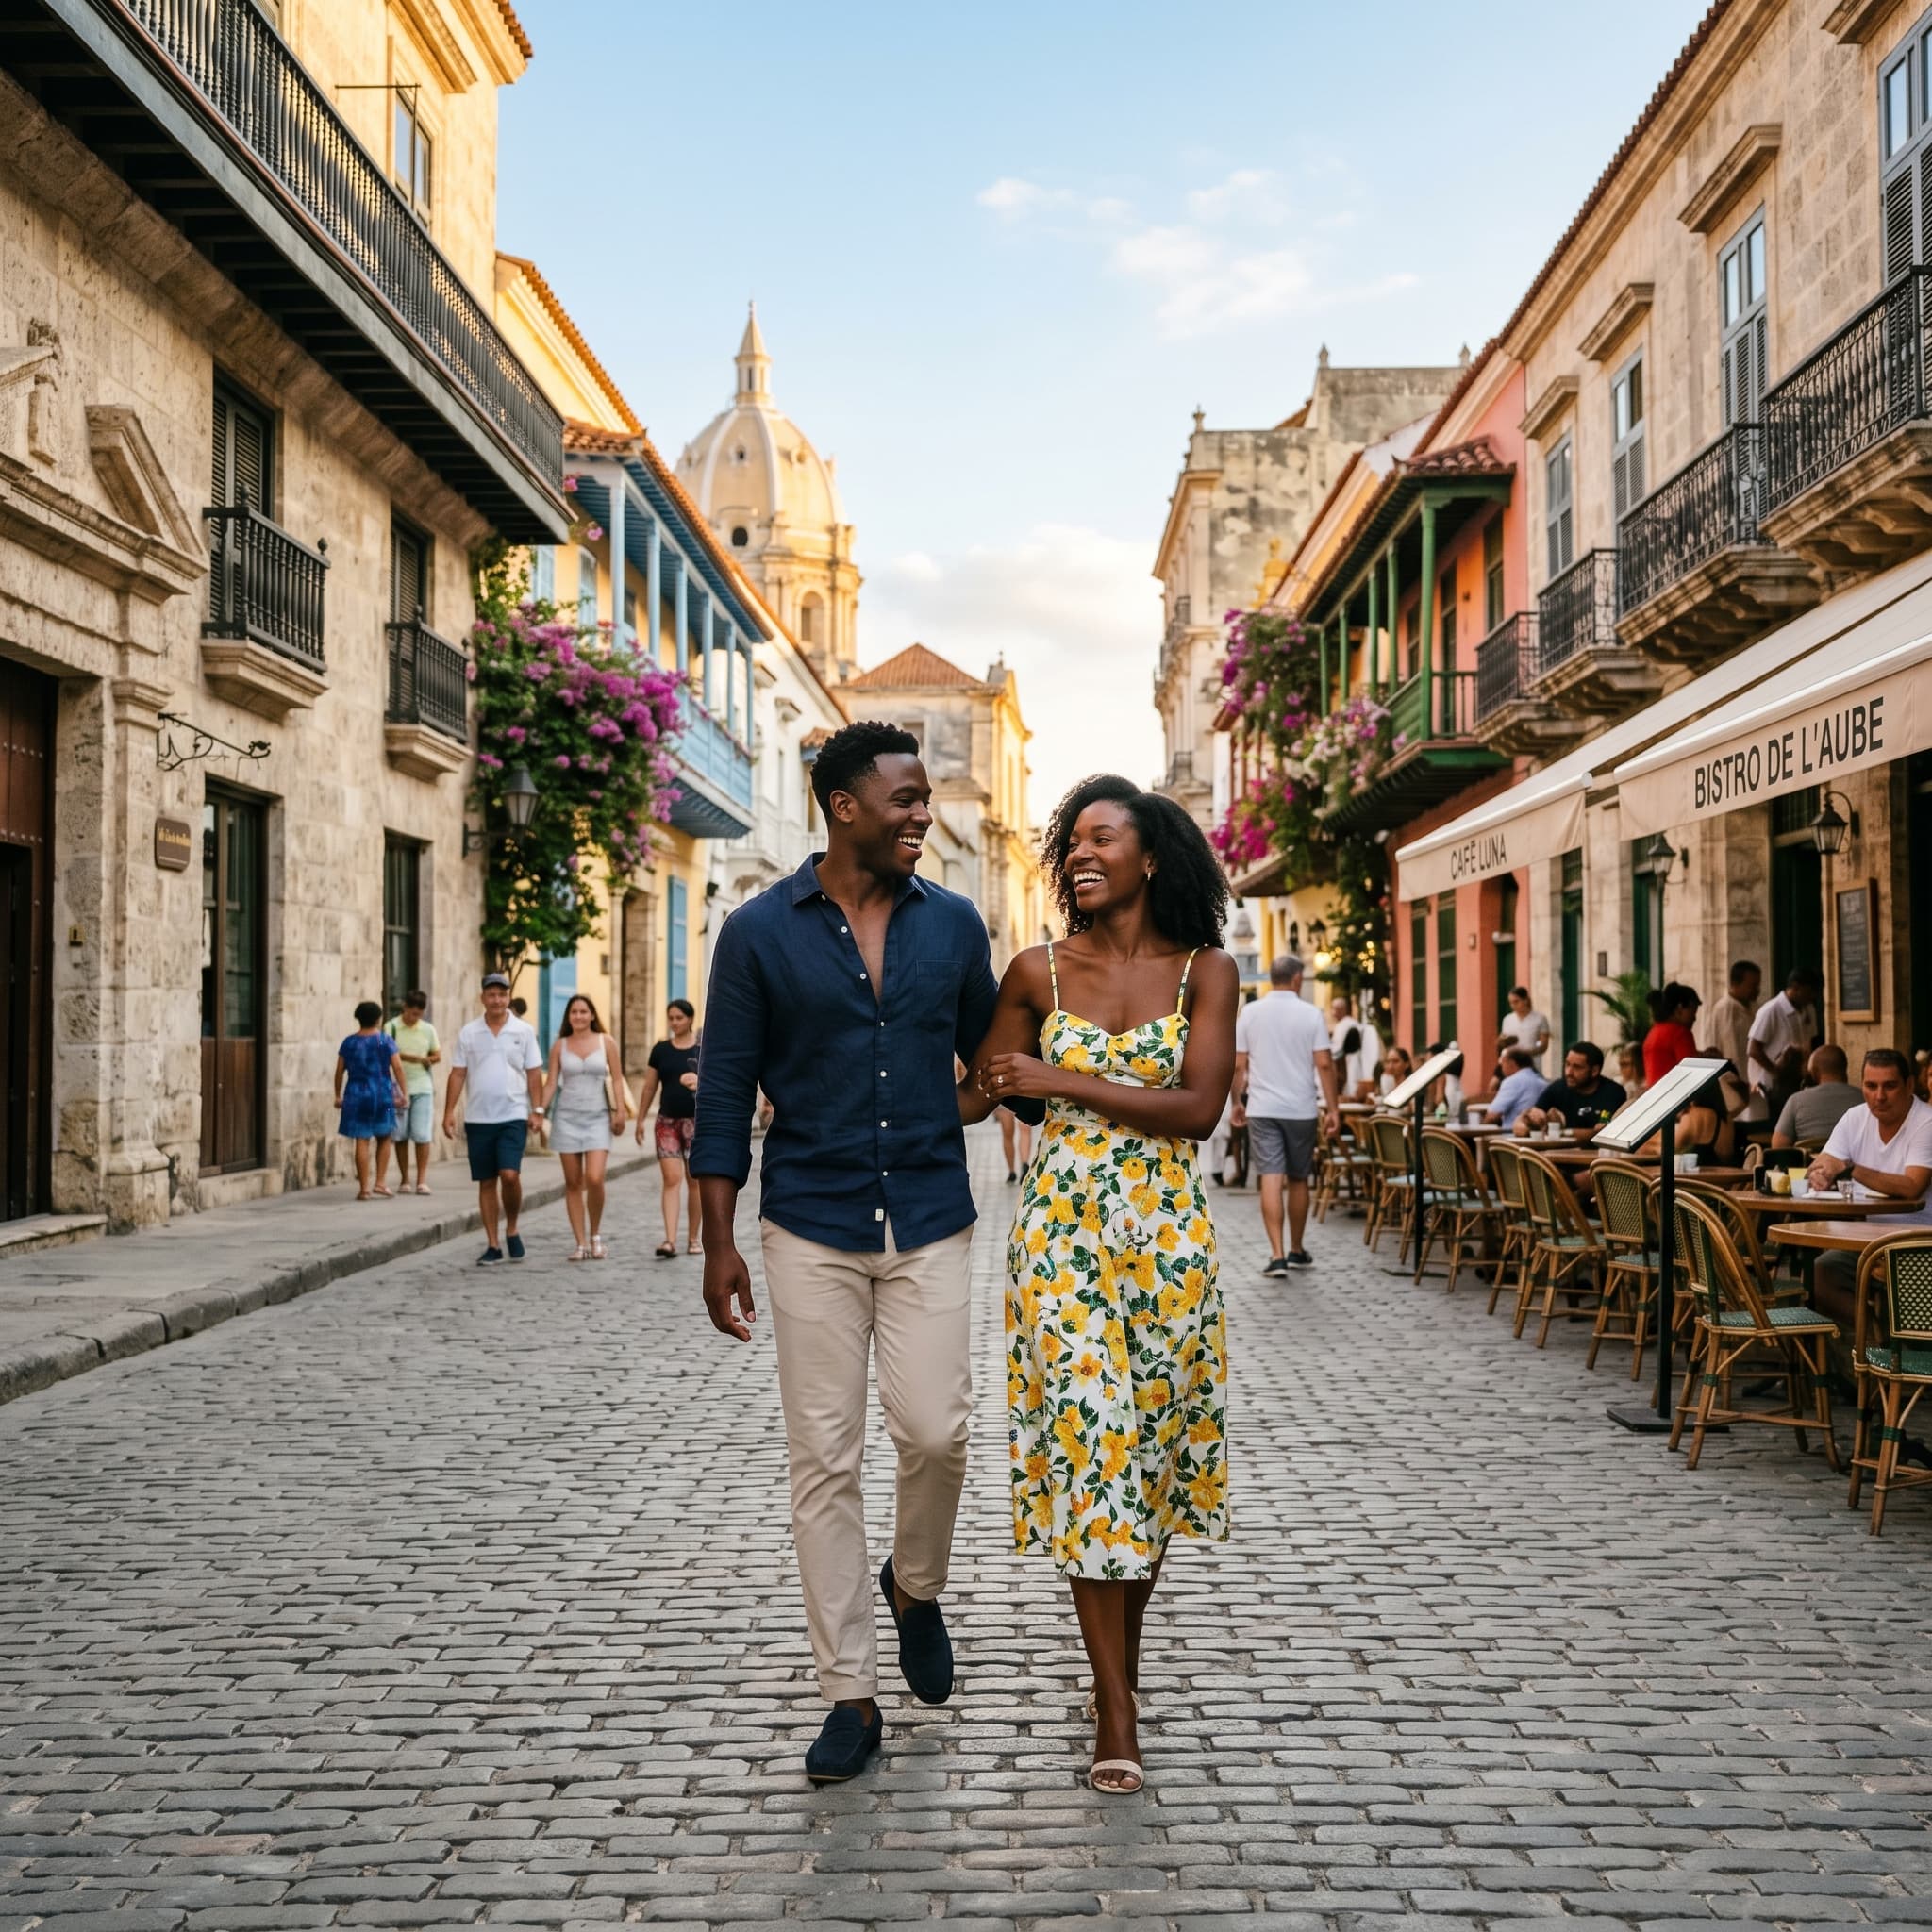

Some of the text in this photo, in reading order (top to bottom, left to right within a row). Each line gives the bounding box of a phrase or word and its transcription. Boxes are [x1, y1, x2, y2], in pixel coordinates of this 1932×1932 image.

[1695, 696, 1884, 809] BISTRO DE L'AUBE
[1451, 833, 1507, 880] CAFÉ LUNA
